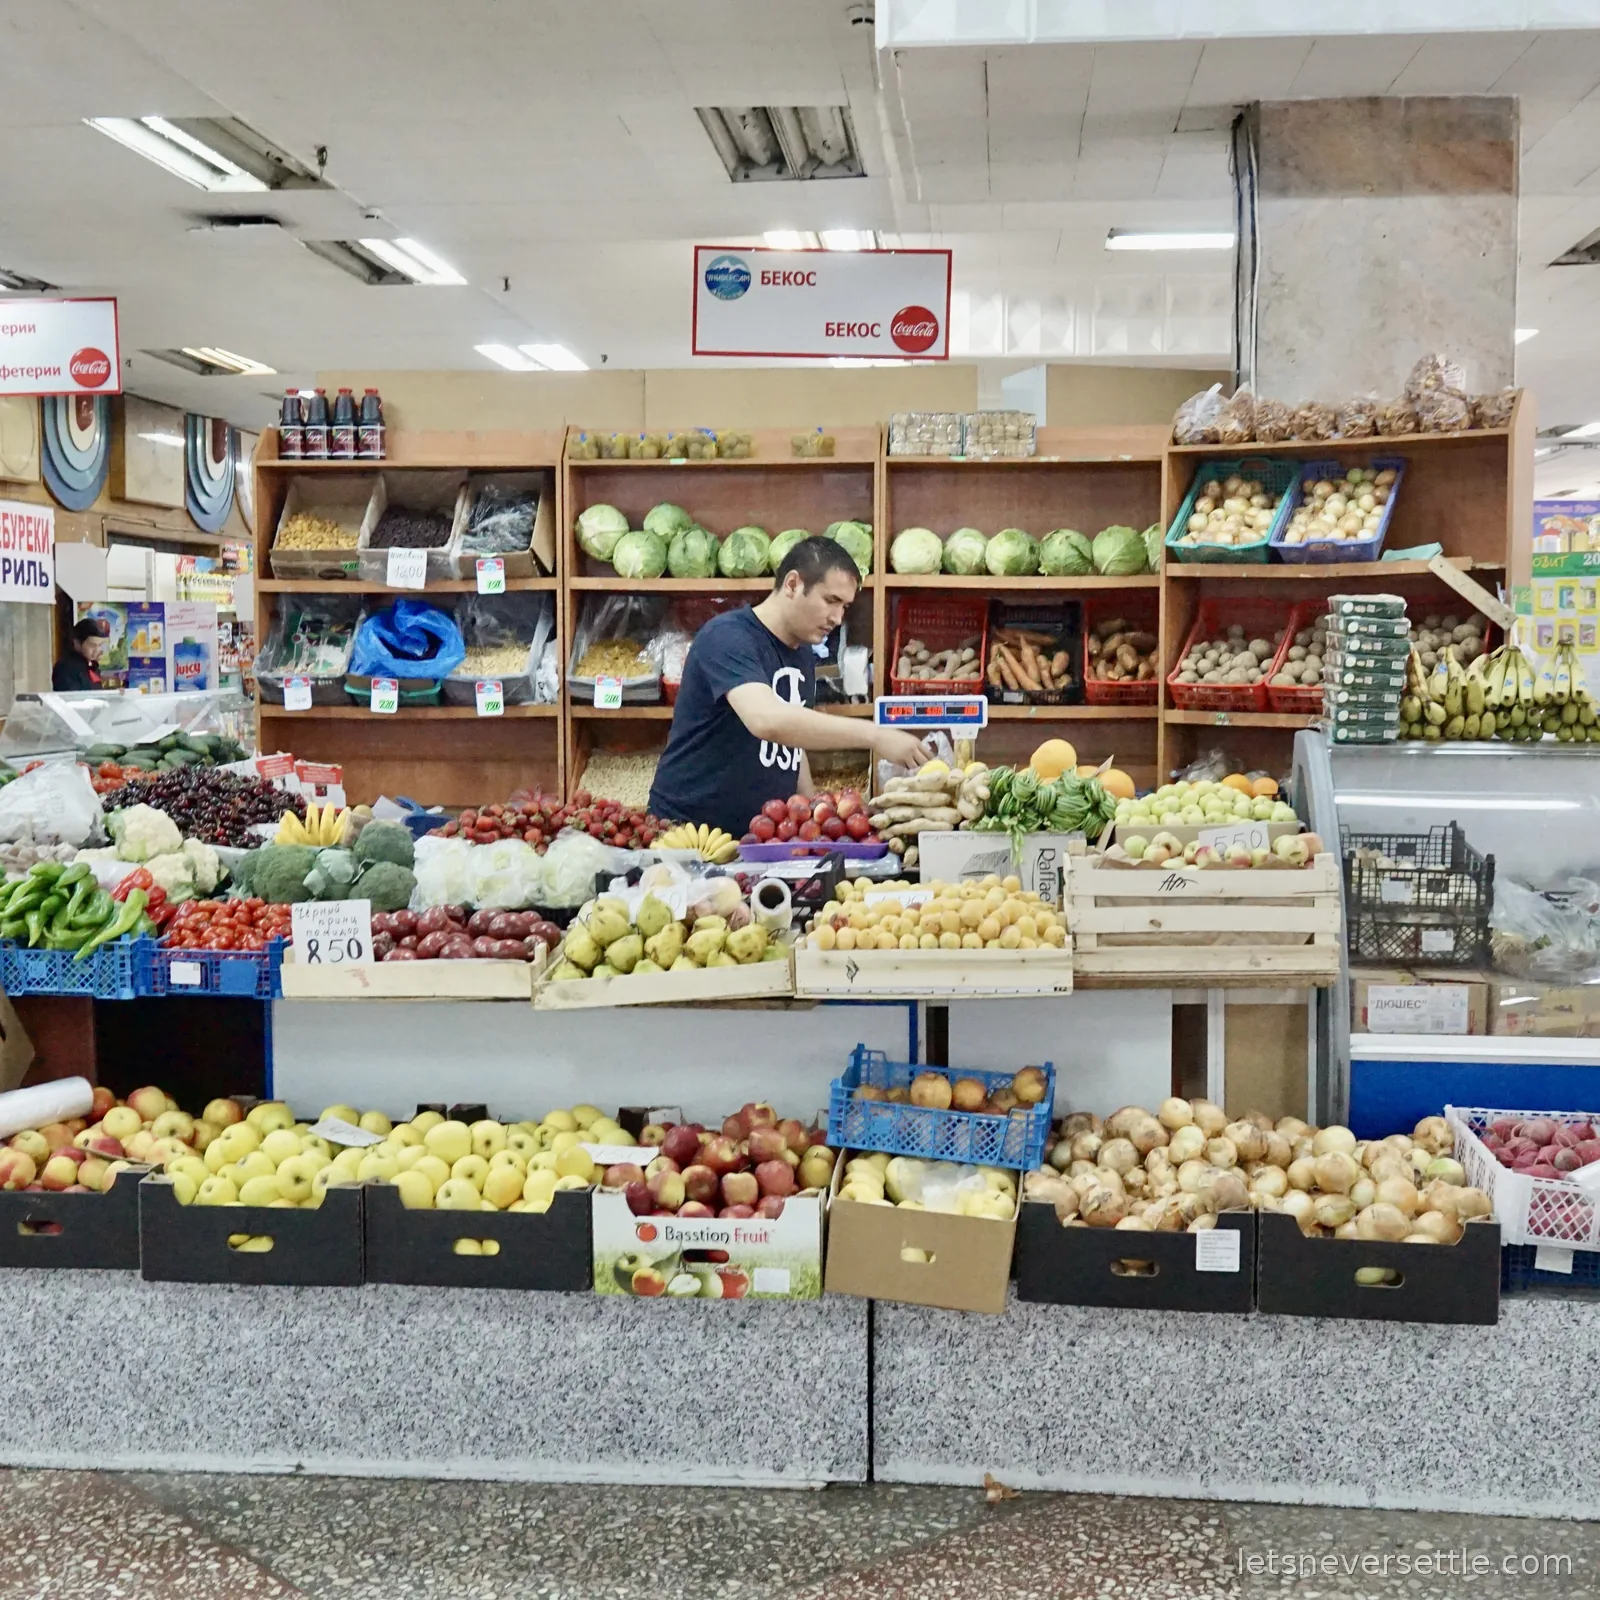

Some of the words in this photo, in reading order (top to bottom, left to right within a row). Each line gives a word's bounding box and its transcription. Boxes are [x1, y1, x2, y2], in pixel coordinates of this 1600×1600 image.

[760, 270, 818, 287] БЕКОС
[0, 323, 37, 337] ерии
[824, 322, 882, 338] БЕКОС
[0, 364, 61, 380] фетерии
[0, 512, 50, 555] БУРЕКИ
[1038, 848, 1057, 905] Raffae
[307, 938, 364, 965] 850
[664, 1225, 731, 1245] Basstion
[733, 1227, 770, 1244] Fruit
